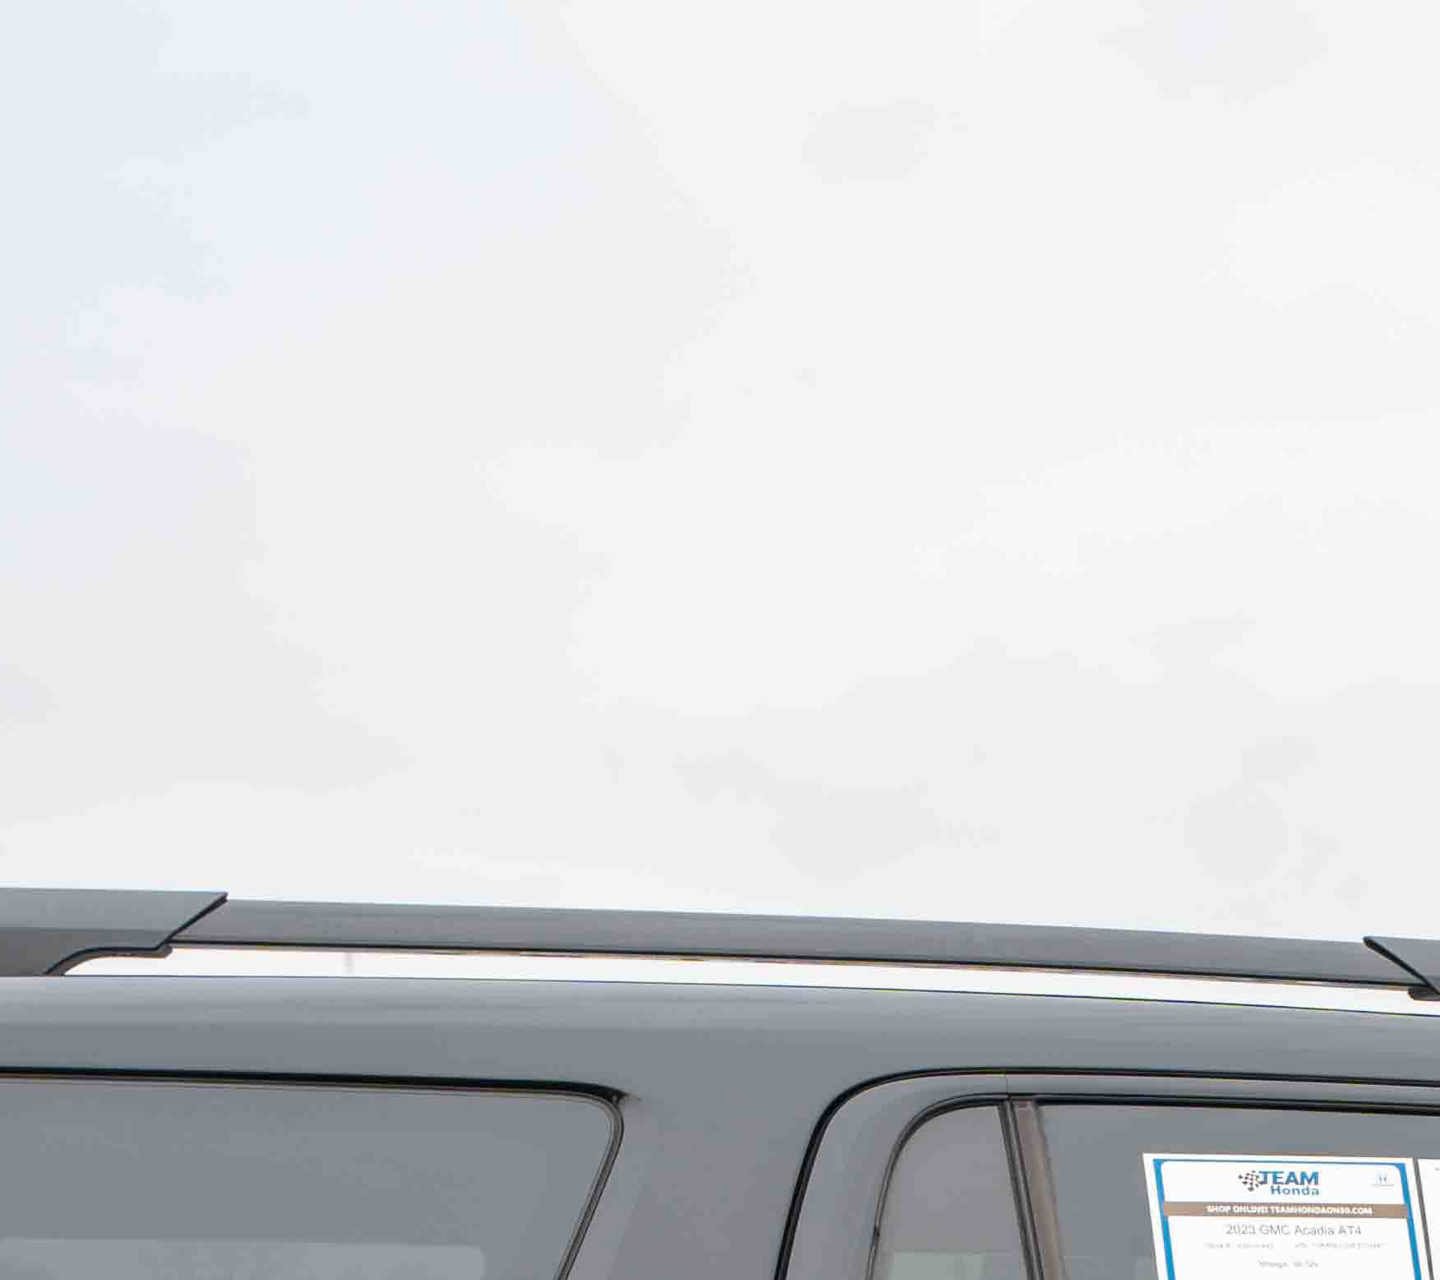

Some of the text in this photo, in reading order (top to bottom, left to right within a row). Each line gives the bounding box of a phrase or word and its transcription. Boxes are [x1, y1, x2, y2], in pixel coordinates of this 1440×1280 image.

[1258, 1171, 1319, 1185] TEAM
[1271, 1186, 1320, 1196] Honda
[1206, 1205, 1231, 1213] SHOP
[1259, 1224, 1290, 1235] GMC
[1294, 1225, 1335, 1236] Acadia
[1338, 1226, 1362, 1235] AT4
